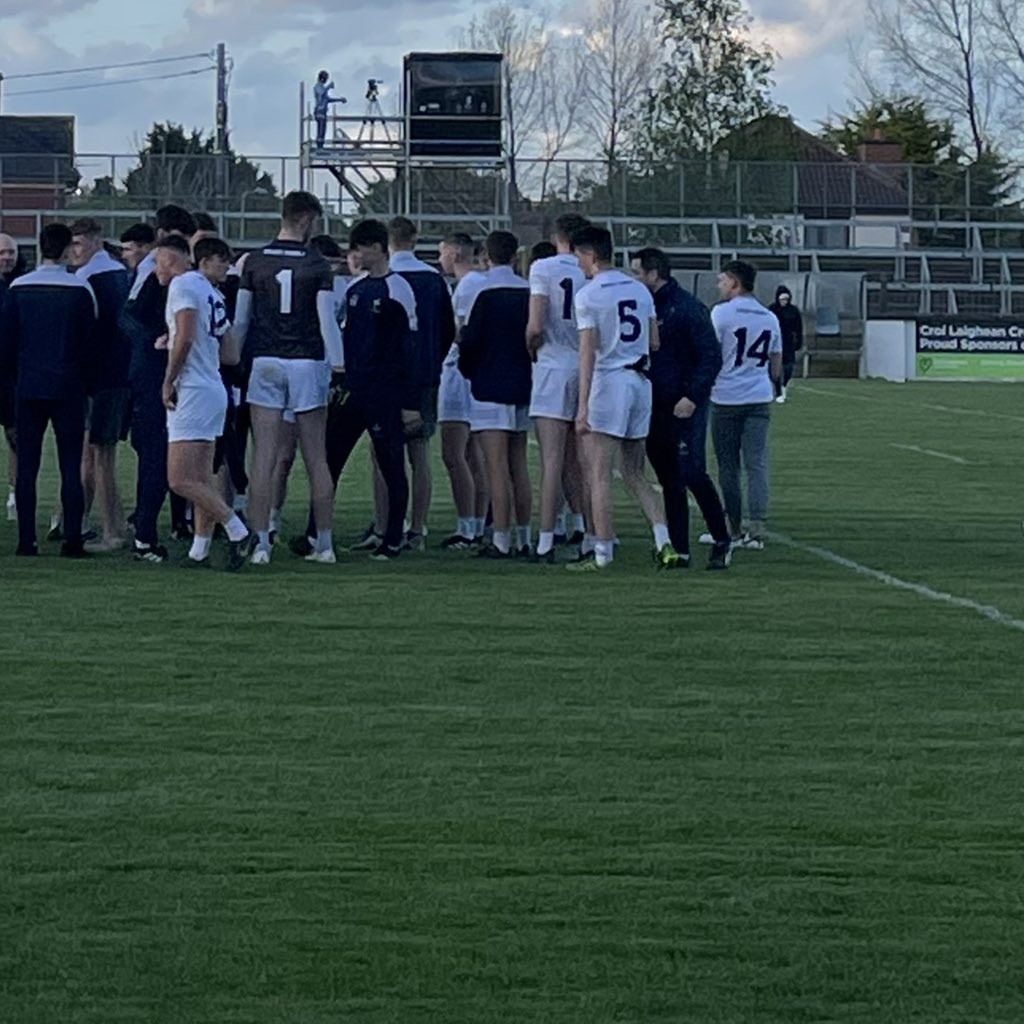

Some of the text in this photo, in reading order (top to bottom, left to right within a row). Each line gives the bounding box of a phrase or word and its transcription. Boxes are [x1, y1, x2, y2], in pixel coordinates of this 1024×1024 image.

[275, 269, 293, 314] 1
[617, 299, 641, 343] 5
[733, 326, 772, 367] 14
[919, 338, 958, 350] Proud
[959, 338, 1018, 351] Sponsors
